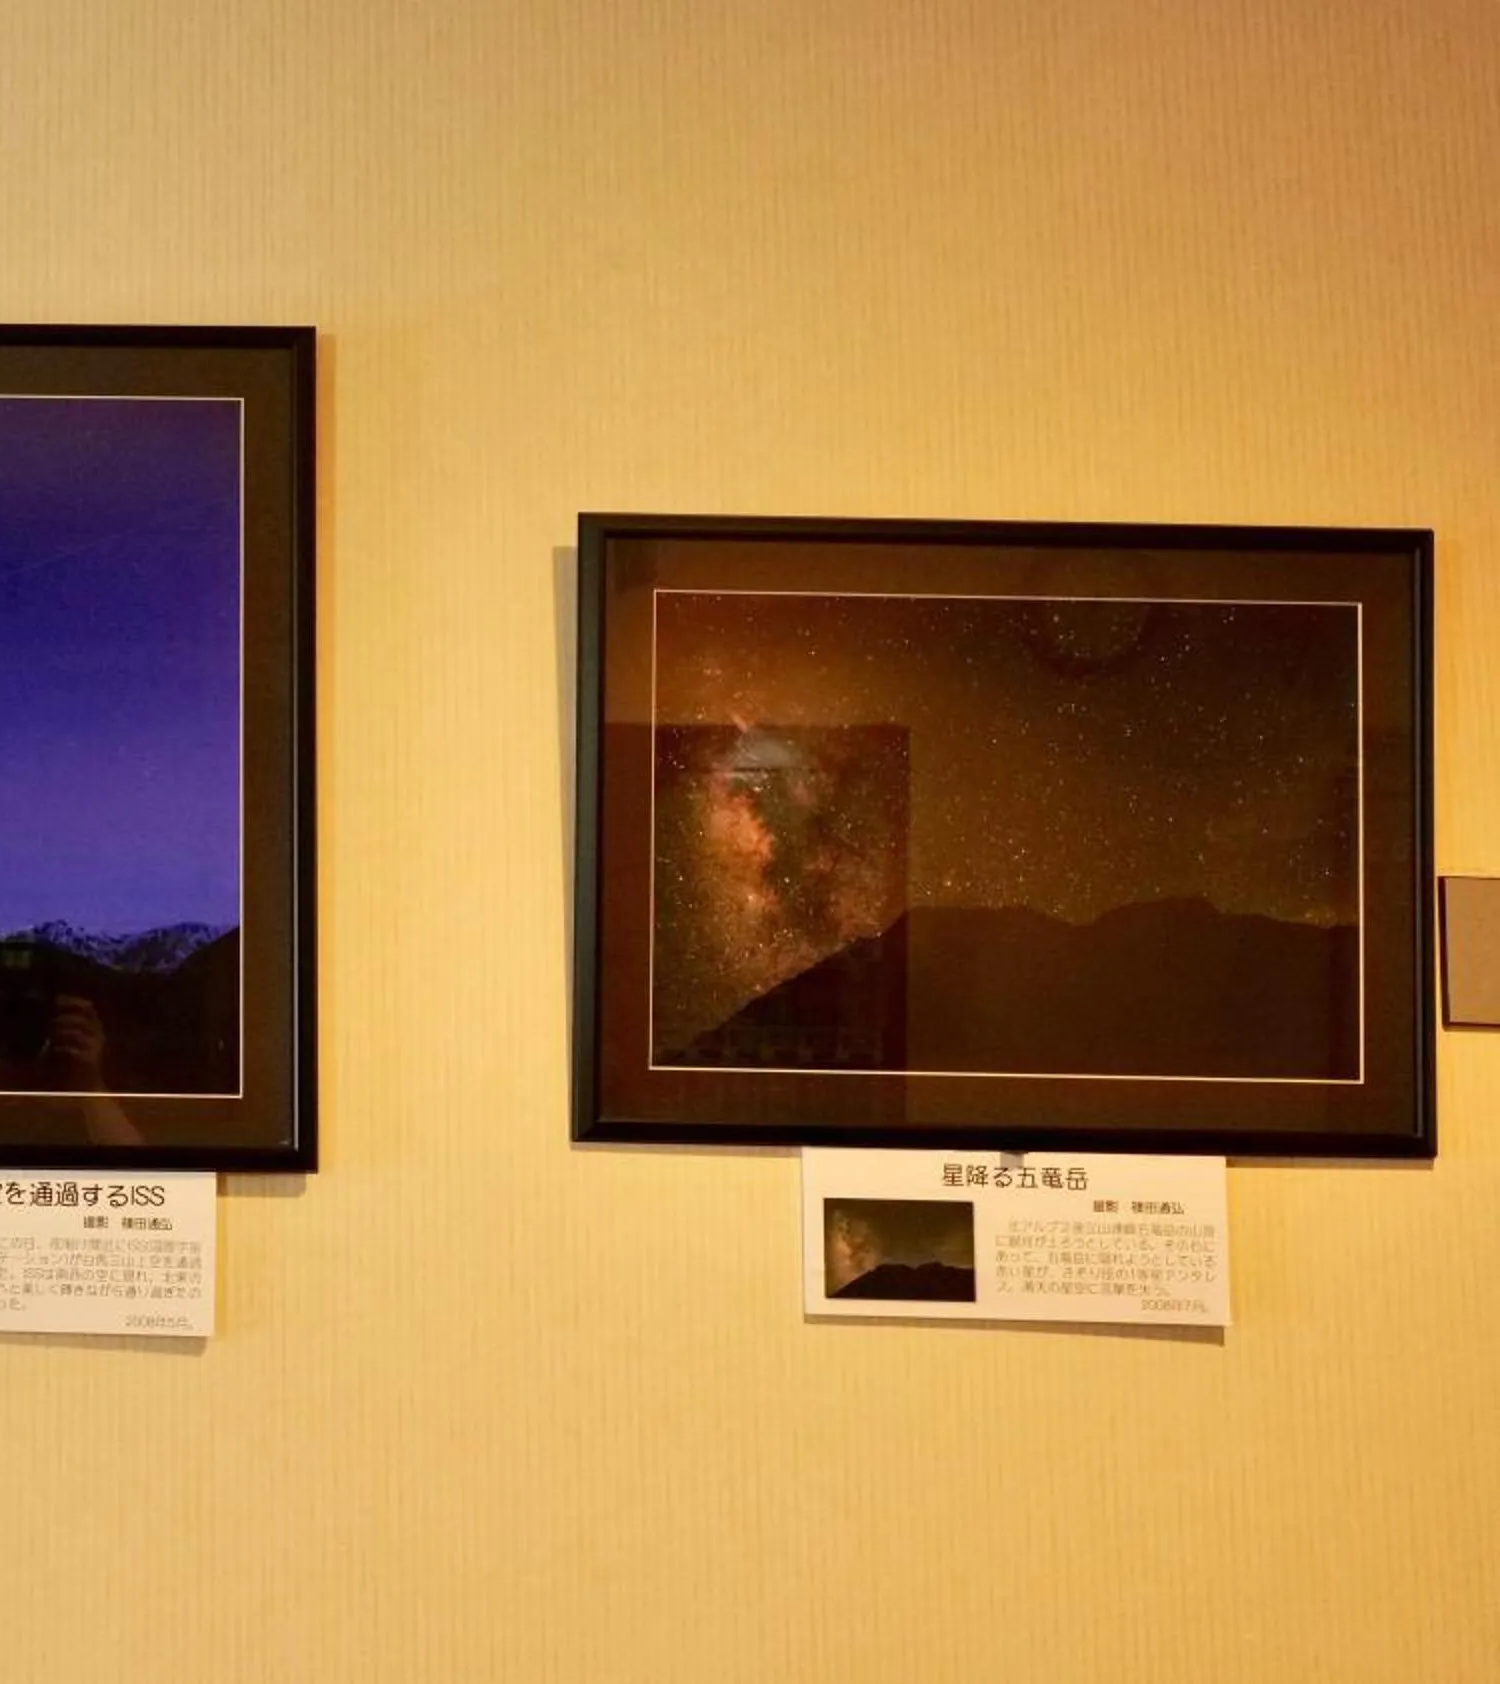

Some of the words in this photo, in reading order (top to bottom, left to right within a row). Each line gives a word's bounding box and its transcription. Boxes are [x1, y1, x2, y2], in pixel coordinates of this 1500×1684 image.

[942, 1163, 1088, 1191] 星降る五竜岳
